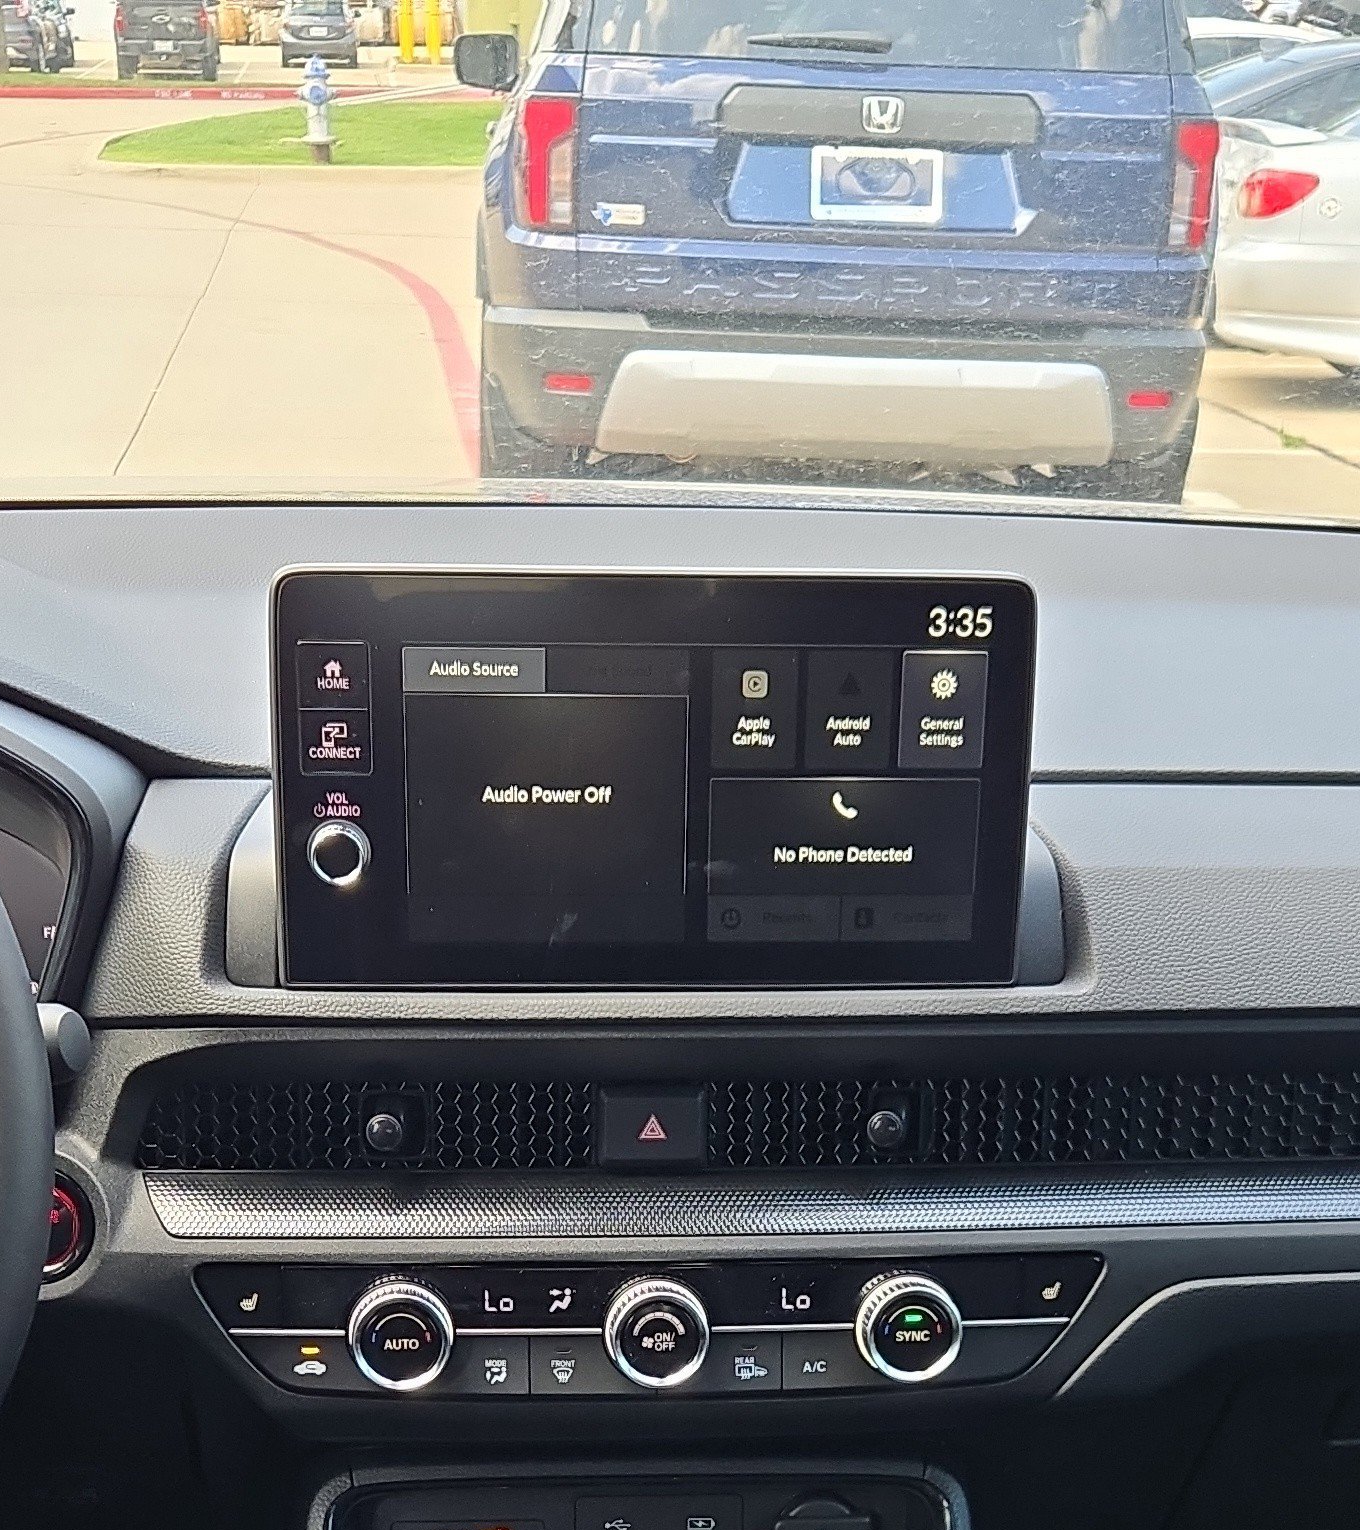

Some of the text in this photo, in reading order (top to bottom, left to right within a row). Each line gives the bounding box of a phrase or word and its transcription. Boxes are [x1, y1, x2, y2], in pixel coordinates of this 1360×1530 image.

[928, 605, 993, 638] 3:35
[429, 659, 519, 677] Audio Source
[316, 676, 350, 690] HOME
[737, 715, 771, 732] Apple
[826, 715, 871, 731] Android
[920, 716, 964, 731] General
[732, 731, 776, 748] CarPlay
[833, 732, 862, 746] Auto
[919, 732, 964, 748] Settings
[308, 746, 362, 760] CONNECT
[326, 792, 349, 805] VOL
[481, 784, 613, 804] Audio Power Off
[326, 804, 361, 817] AUDIO
[773, 845, 914, 863] No Phone Detected
[484, 1289, 515, 1312] Lo
[781, 1287, 811, 1311] Lo
[654, 1331, 676, 1343] ON/
[895, 1329, 931, 1342] SYNC
[383, 1338, 420, 1351] AUTO
[654, 1342, 676, 1353] OFF
[484, 1358, 508, 1368] MODE
[550, 1358, 576, 1368] FRONT
[734, 1355, 756, 1365] REAR
[802, 1359, 828, 1373] A/C
